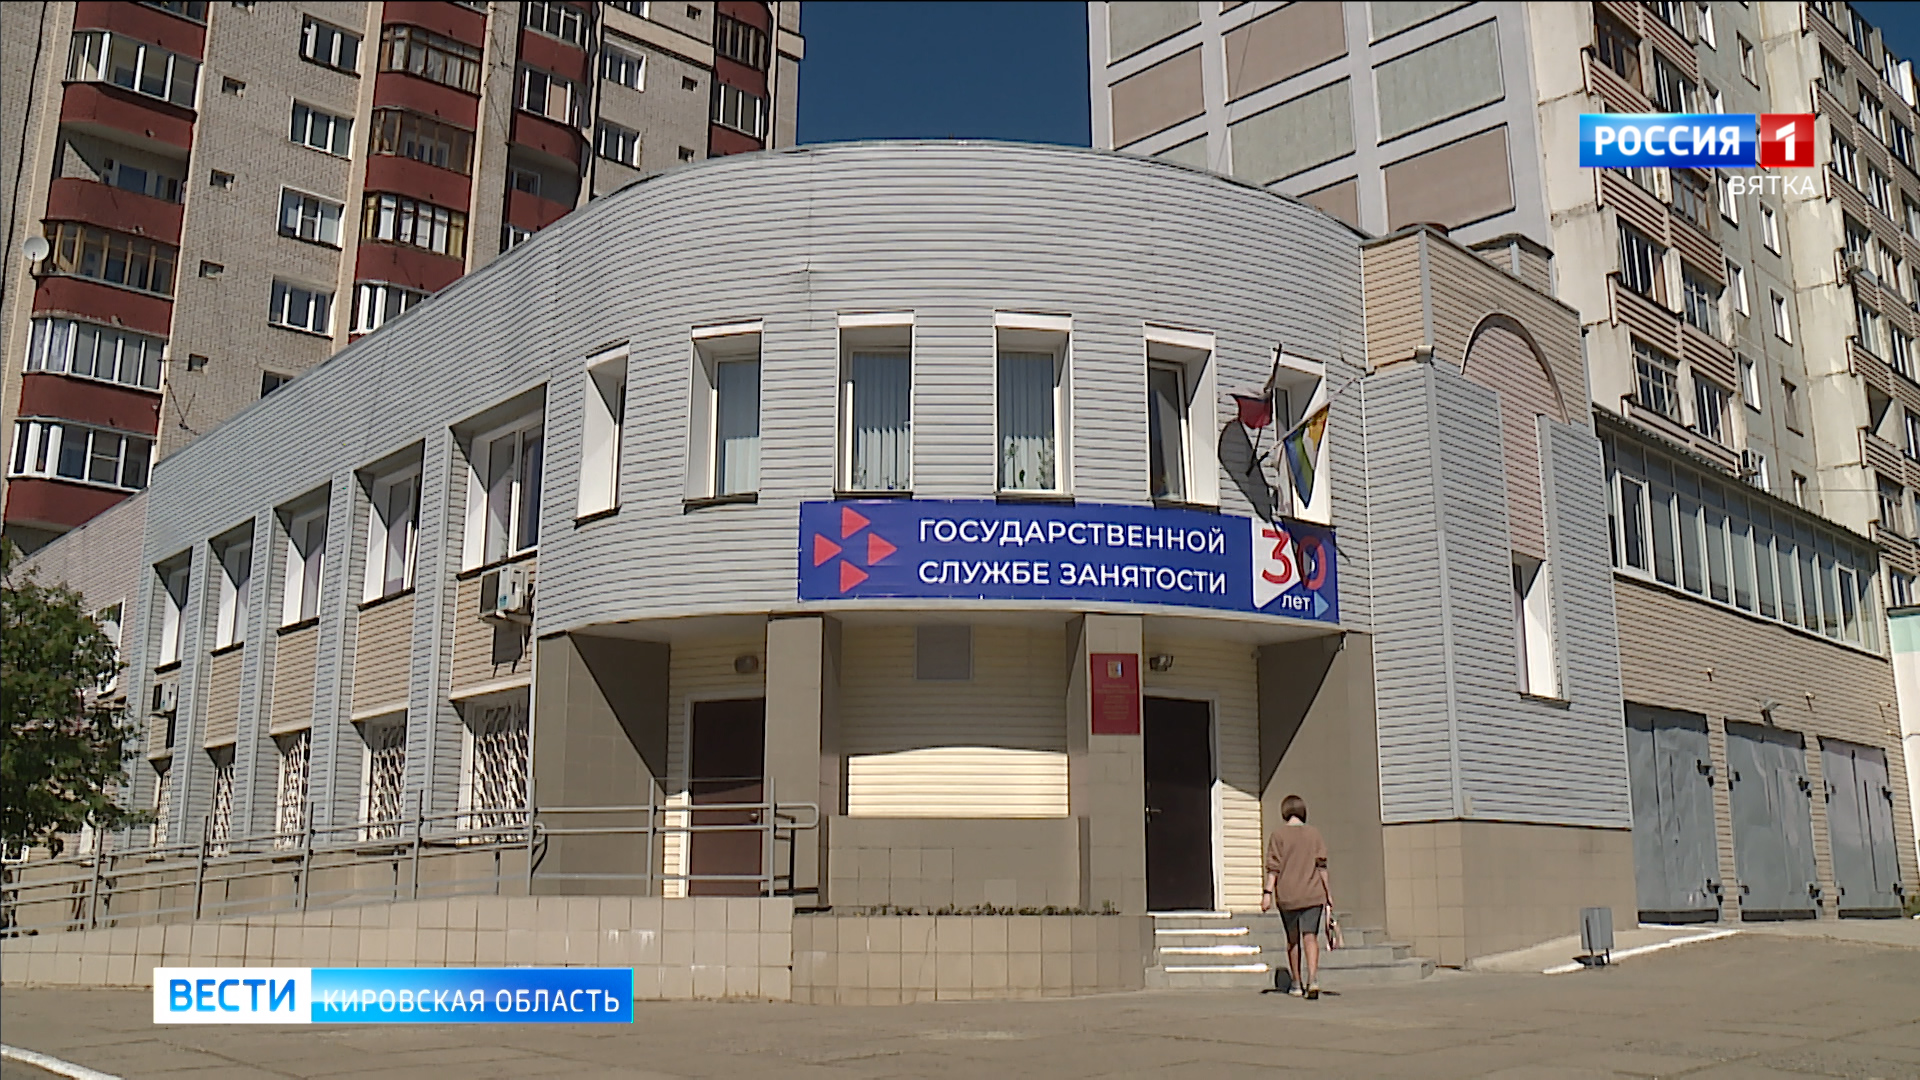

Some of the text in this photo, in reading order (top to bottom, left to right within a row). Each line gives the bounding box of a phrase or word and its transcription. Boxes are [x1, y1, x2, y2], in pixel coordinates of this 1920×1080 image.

[919, 519, 1226, 554] ГОСУДАРСТВЕННОЙ
[1261, 529, 1327, 591] 30
[919, 561, 1227, 595] СЛУЖБЕ ЗАНЯТОСТИ
[1281, 595, 1311, 611] лет
